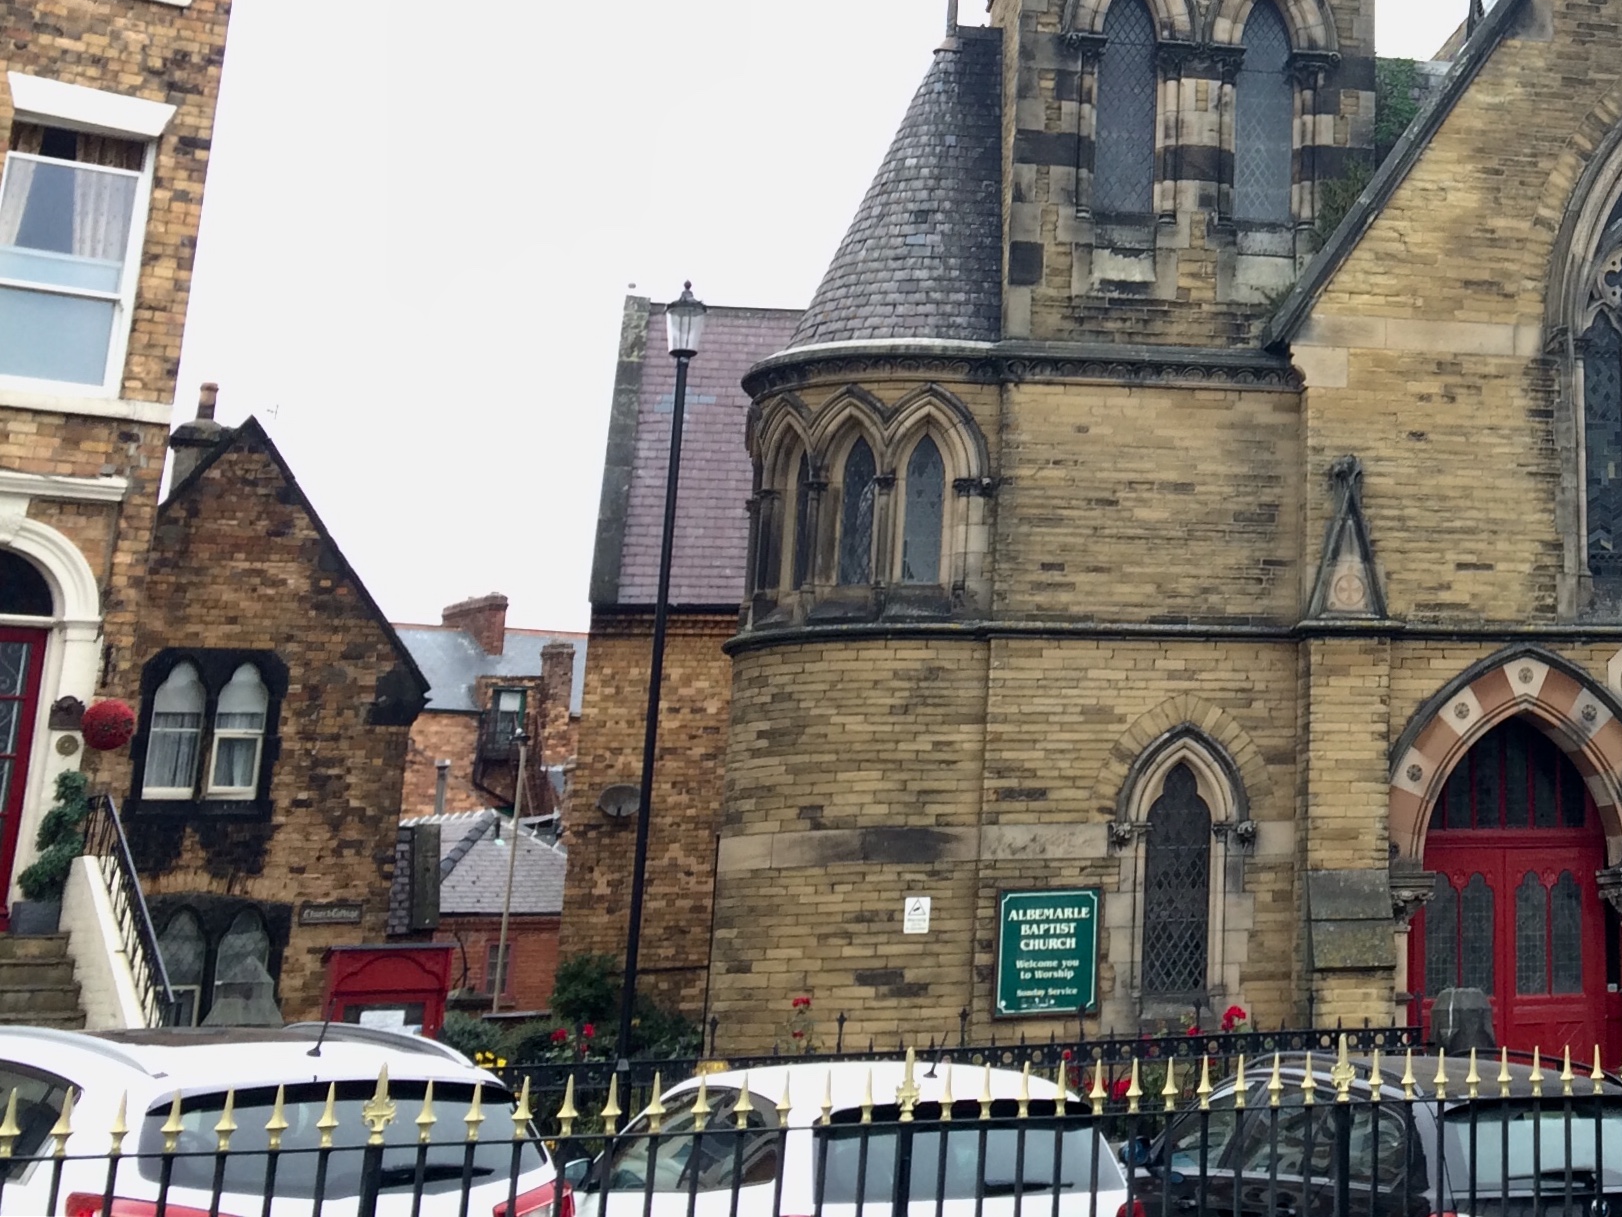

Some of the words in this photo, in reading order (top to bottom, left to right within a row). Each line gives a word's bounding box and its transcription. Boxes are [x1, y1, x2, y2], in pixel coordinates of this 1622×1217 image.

[1008, 907, 1090, 921] ALBEMARLE
[1020, 923, 1077, 935] BAPTIST
[1020, 937, 1076, 951] CHURCH
[1016, 959, 1058, 969] Welcome
[1061, 959, 1080, 969] you
[1020, 970, 1032, 979] to
[1034, 968, 1074, 979] Worship
[1016, 988, 1046, 997] Sunday
[1047, 987, 1078, 996] Service
